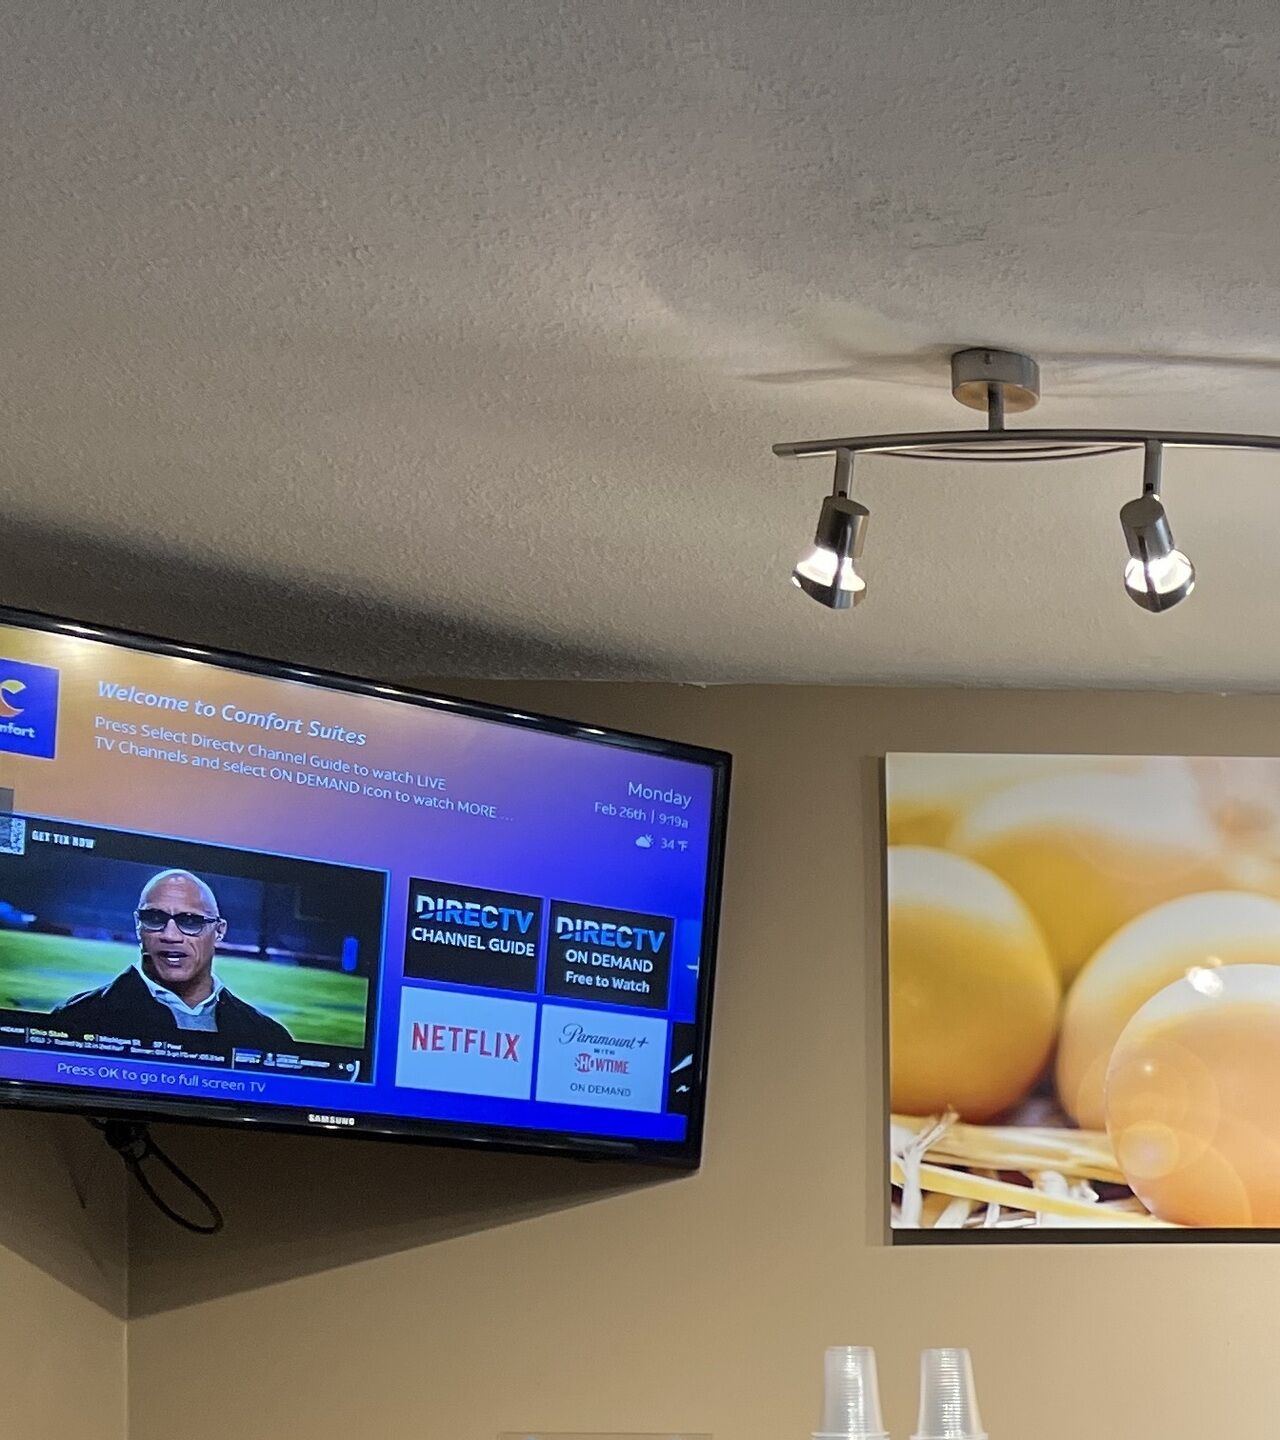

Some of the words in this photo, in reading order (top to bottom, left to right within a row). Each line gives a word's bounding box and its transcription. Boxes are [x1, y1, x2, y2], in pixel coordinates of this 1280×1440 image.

[98, 680, 189, 712] Welcome
[194, 700, 216, 717] to
[222, 705, 303, 734] Comfort
[307, 720, 367, 746] Suites
[95, 716, 137, 735] Press
[141, 724, 188, 744] Select
[191, 733, 245, 754] Directv
[247, 744, 306, 766] Channel
[309, 754, 350, 773] Guide
[354, 764, 369, 776] to
[373, 767, 414, 785] watch
[416, 774, 447, 790] LIVE
[95, 735, 116, 751] TV
[118, 741, 188, 764] Channels
[192, 756, 219, 769] and
[223, 760, 267, 778] select
[270, 767, 293, 783] ON
[296, 772, 361, 794] DEMAND
[362, 785, 392, 800] icon
[395, 790, 411, 803] to
[413, 793, 454, 812] watch
[457, 800, 498, 819] MORE
[628, 781, 692, 810] Monday
[594, 801, 617, 816] Feb
[619, 806, 647, 822] 26th
[661, 838, 675, 850] 34
[416, 895, 534, 934] DIRECTV
[411, 927, 486, 951] CHANNEL
[488, 937, 535, 957] GUIDE
[555, 916, 666, 954] DIRECTV
[565, 949, 588, 965] ON
[592, 954, 654, 974] DEMAND
[565, 970, 593, 986] Free
[595, 976, 610, 988] to
[612, 976, 651, 994] Watch
[411, 1022, 521, 1063] NETFLIX
[558, 1022, 649, 1051] Paramount+
[57, 1062, 96, 1077] Press
[98, 1066, 119, 1079] OK
[122, 1070, 137, 1081] to
[140, 1073, 158, 1085] go
[161, 1073, 176, 1085] to
[178, 1074, 199, 1087] full
[202, 1078, 245, 1092] screen
[250, 1080, 267, 1093] TV
[574, 1053, 631, 1075] SHOWTIME
[569, 1082, 586, 1093] ON
[588, 1084, 632, 1098] DEMAND
[307, 1113, 356, 1126] SAMSUNG
